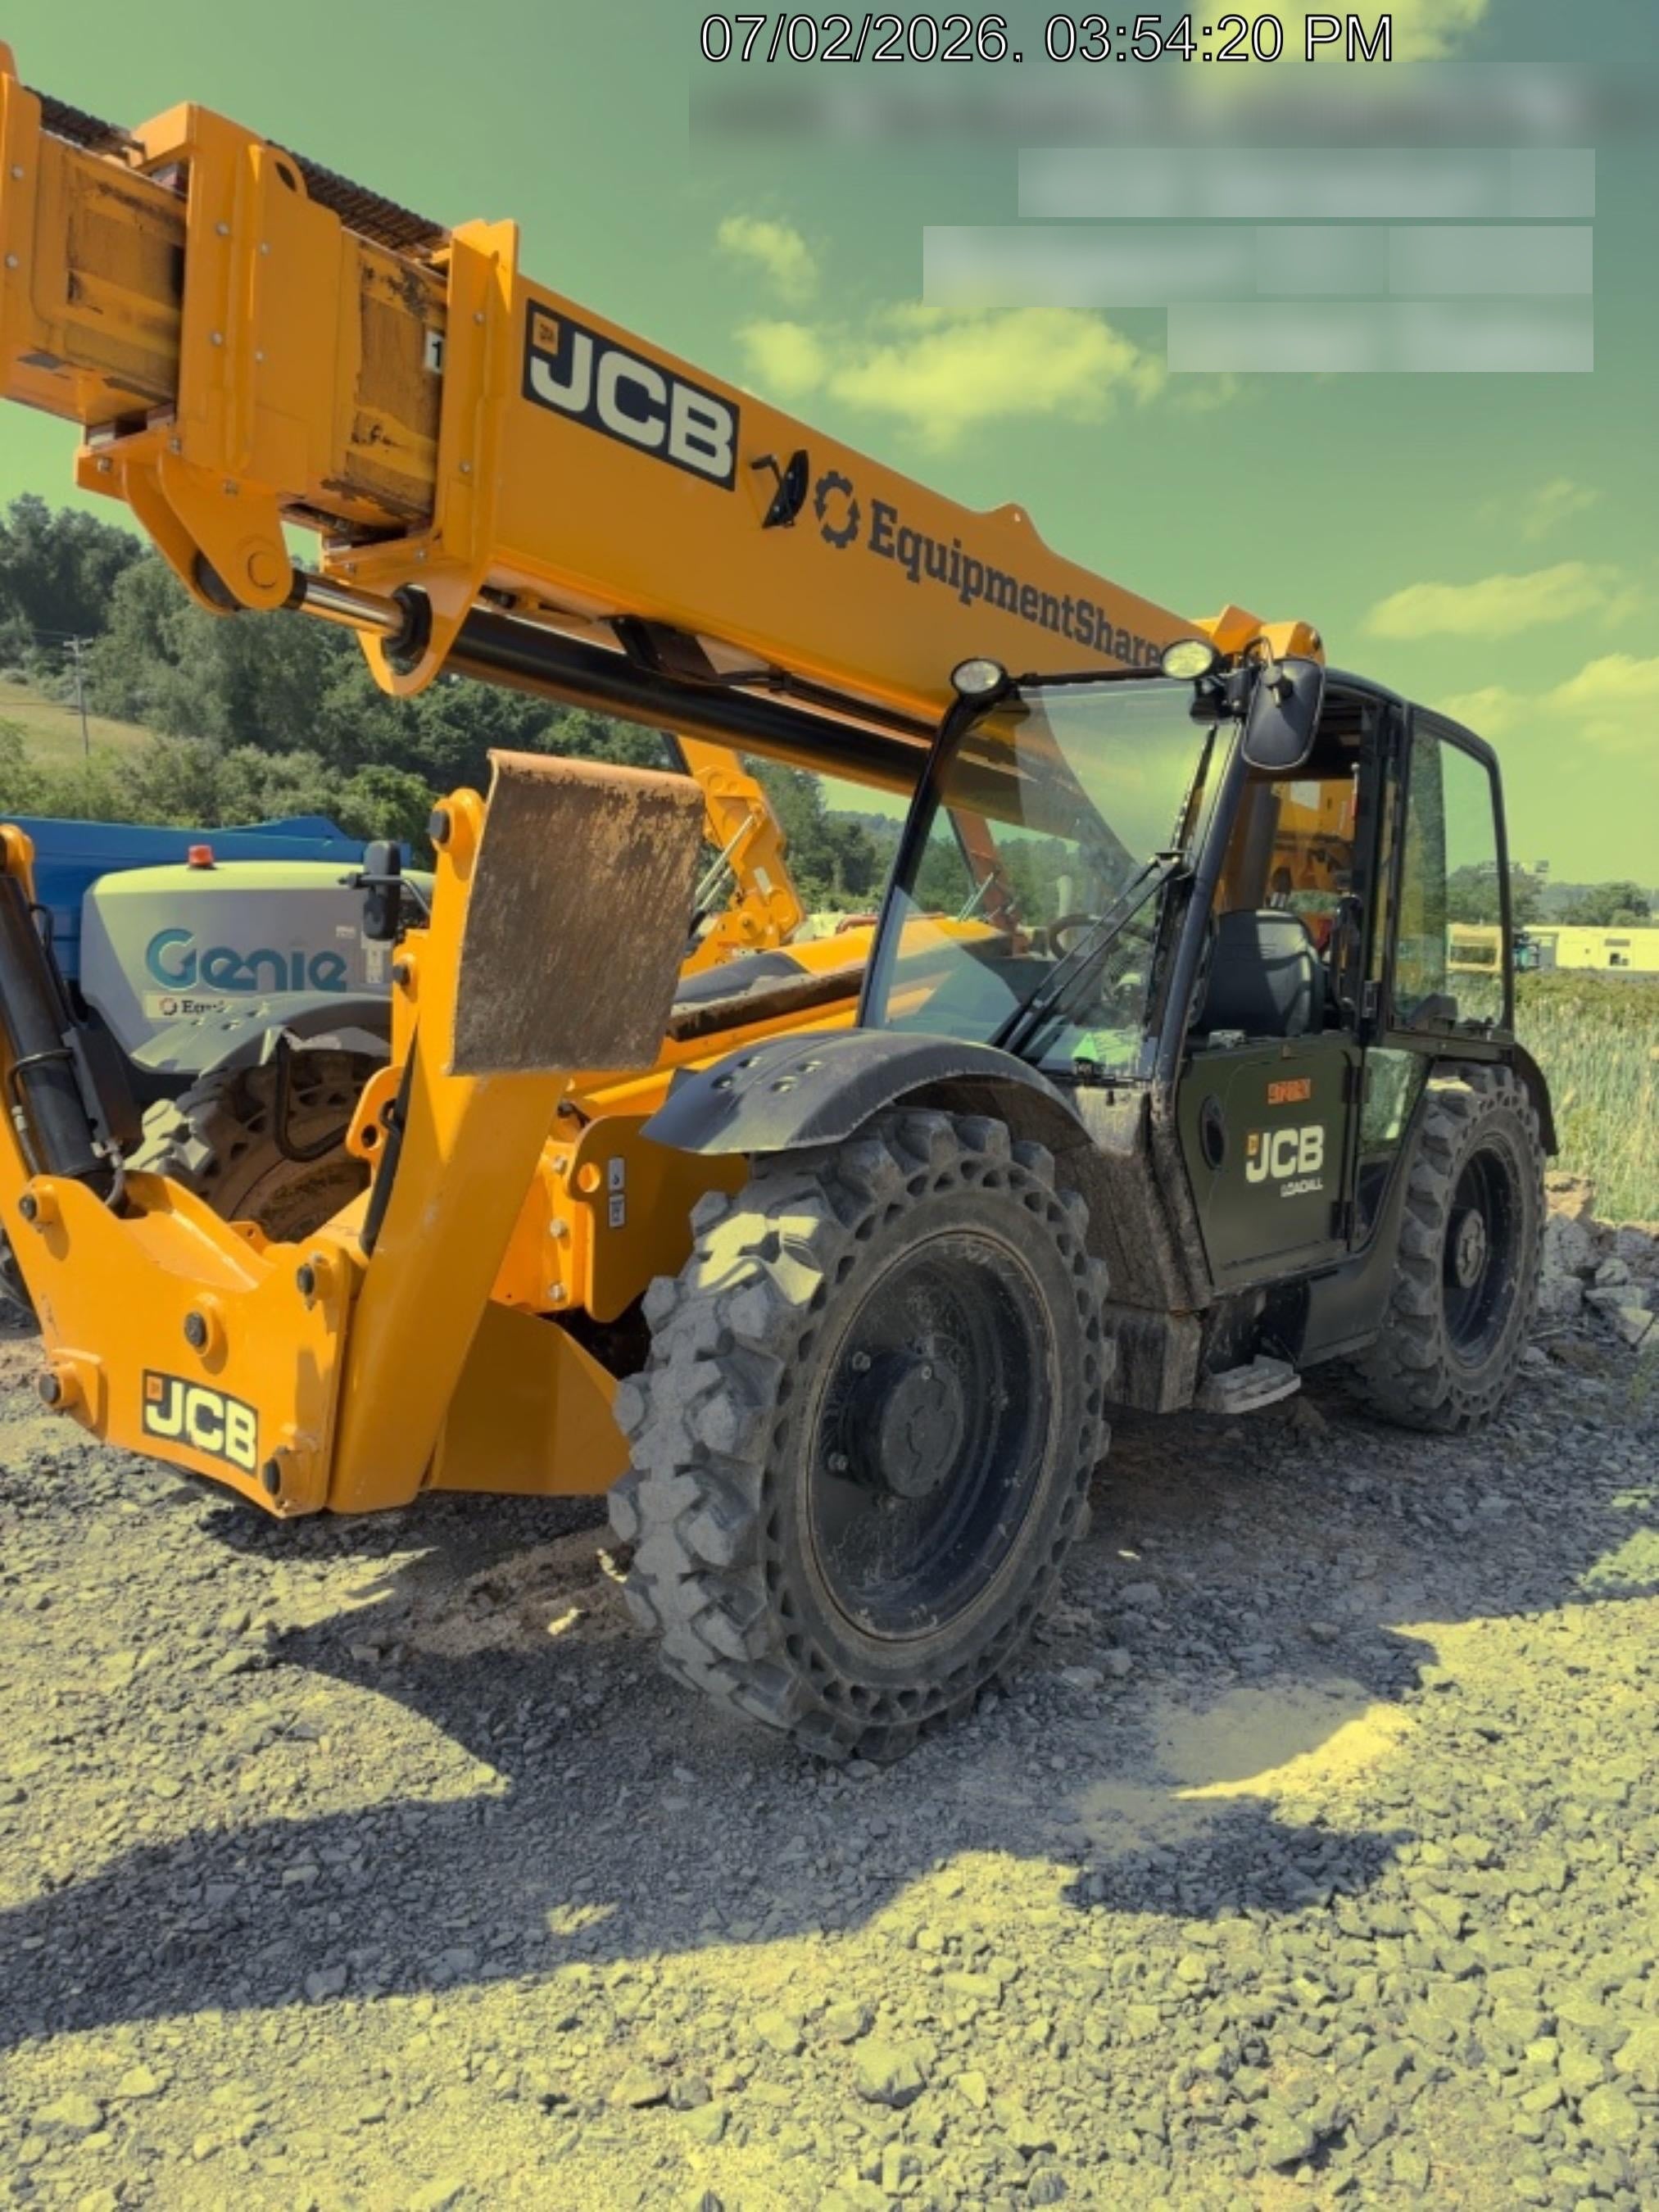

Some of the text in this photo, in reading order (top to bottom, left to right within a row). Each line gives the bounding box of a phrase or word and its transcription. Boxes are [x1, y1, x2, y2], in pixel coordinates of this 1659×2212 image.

[530, 331, 734, 478] JCB
[145, 928, 347, 991] Genie
[1245, 1125, 1324, 1183] JCB
[145, 1381, 256, 1470] JCB
